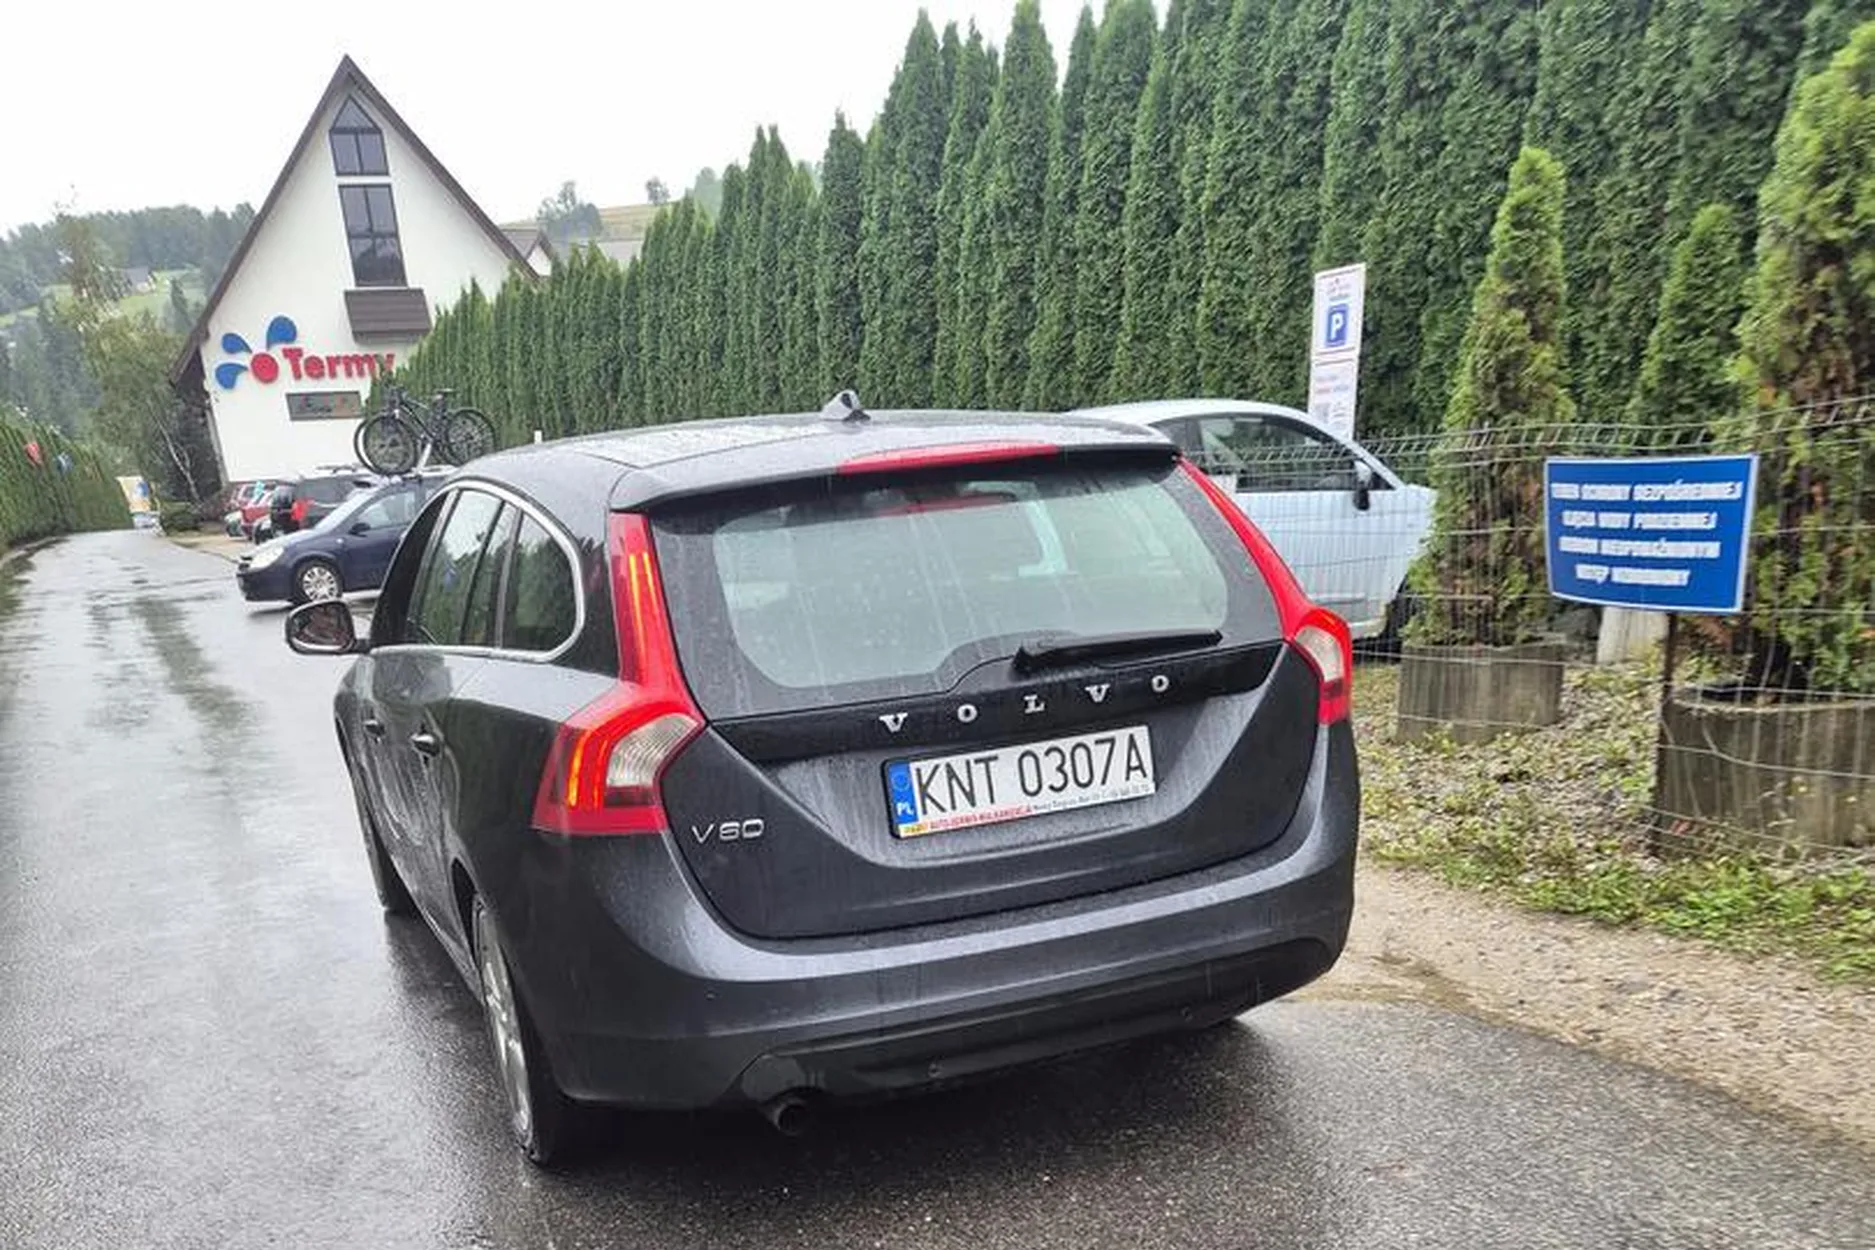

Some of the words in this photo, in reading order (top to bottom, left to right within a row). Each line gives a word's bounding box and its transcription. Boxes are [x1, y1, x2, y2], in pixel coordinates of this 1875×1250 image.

[1330, 312, 1344, 341] P
[879, 674, 1170, 733] VOLVO
[915, 755, 999, 816] KNT
[1017, 733, 1148, 798] 0307A
[896, 802, 914, 816] PL
[691, 818, 764, 843] V60
